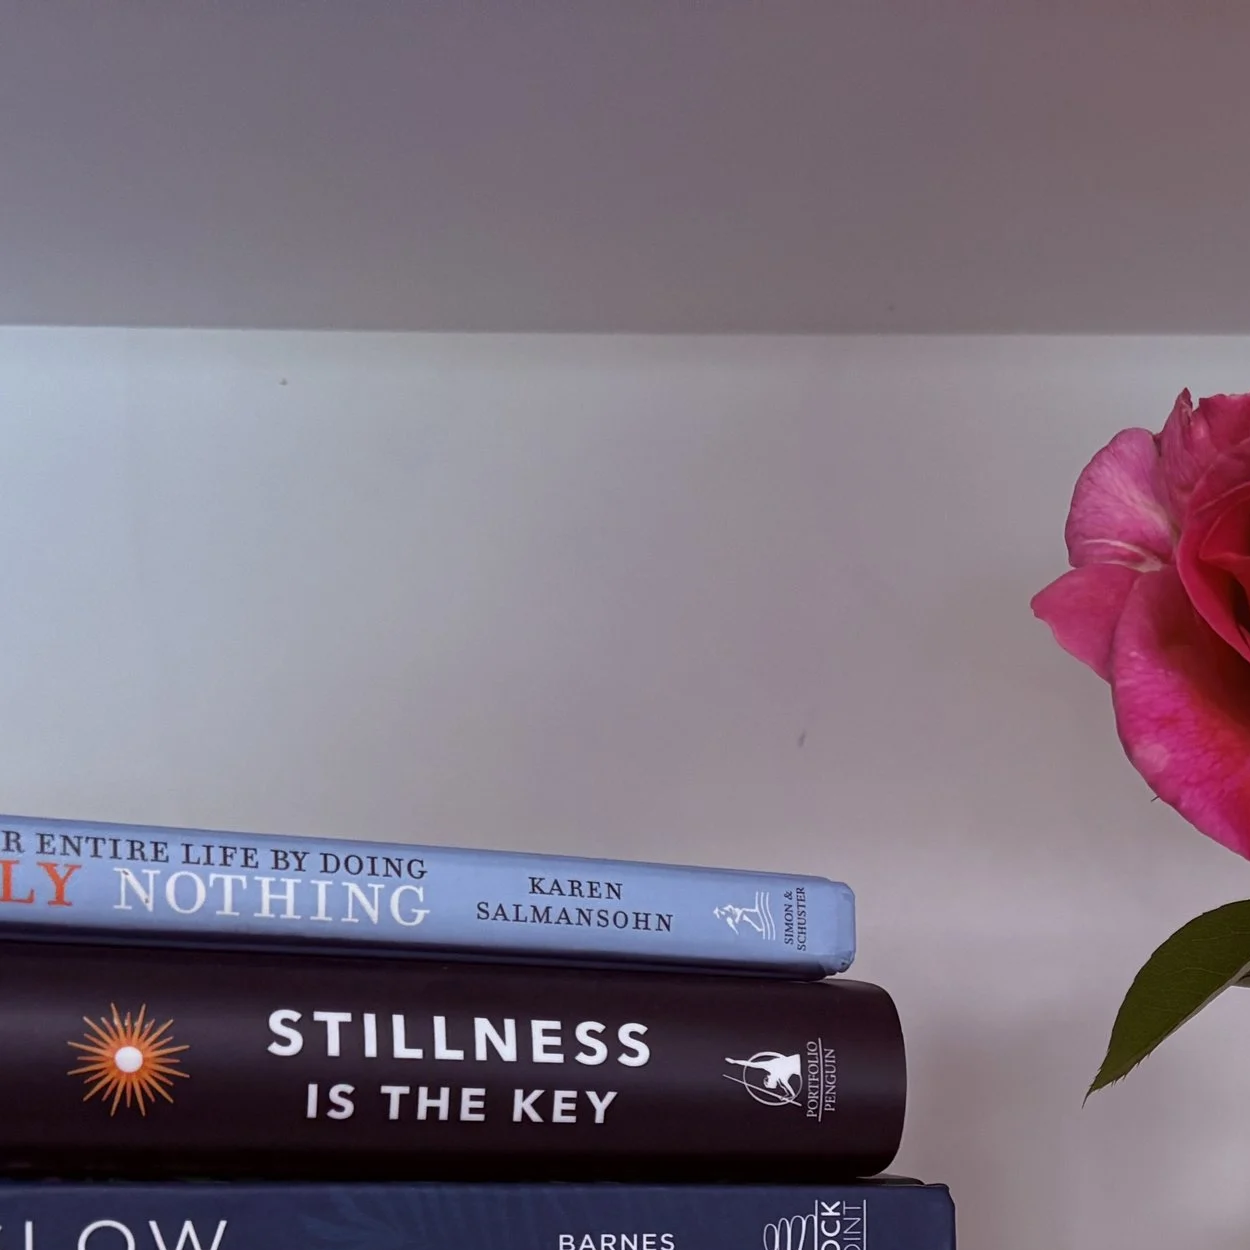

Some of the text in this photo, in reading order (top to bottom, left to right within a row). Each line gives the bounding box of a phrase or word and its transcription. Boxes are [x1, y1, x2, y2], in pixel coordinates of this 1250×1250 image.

[36, 832, 169, 863] ENTIRE
[181, 842, 260, 869] LIFE
[270, 848, 310, 872] BY
[320, 852, 428, 879] DOING
[113, 867, 430, 926] NOTHING
[528, 876, 622, 900] KAREN
[476, 902, 674, 932] SALMANSOHN
[783, 890, 794, 945] SIMON &
[795, 887, 807, 951] SCHUSTER
[267, 1008, 651, 1067] STILLNESS
[306, 1083, 618, 1124] IS THE KEY
[806, 1041, 819, 1118] PORTFOLIO
[823, 1048, 836, 1112] PENGUIN
